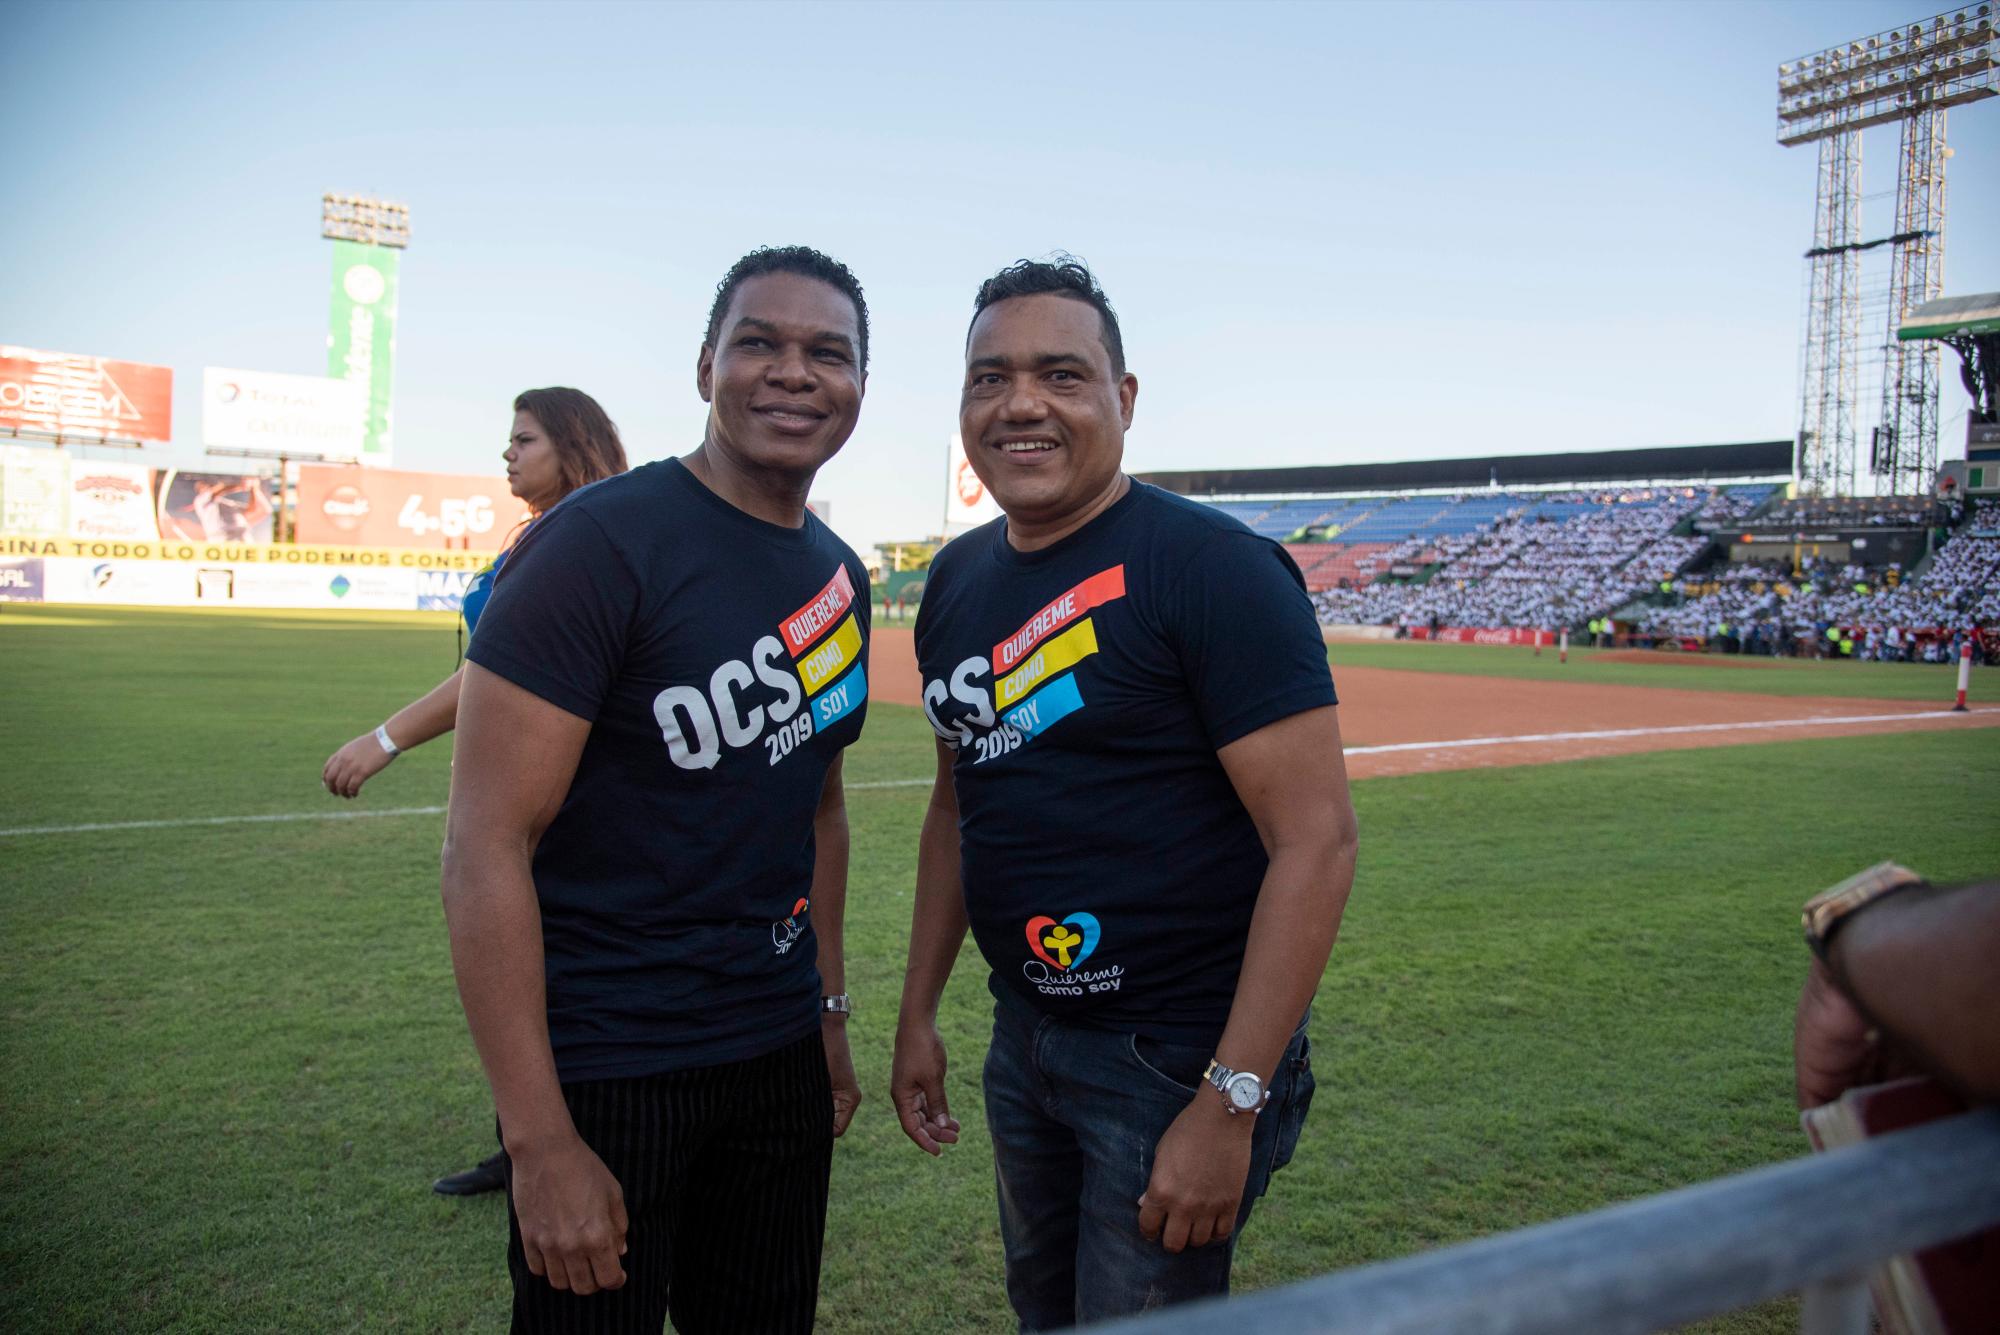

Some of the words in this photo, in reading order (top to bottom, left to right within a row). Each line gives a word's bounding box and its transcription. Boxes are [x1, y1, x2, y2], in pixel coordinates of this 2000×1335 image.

[397, 494, 495, 537] 4.5G
[0, 539, 58, 555] INA
[72, 542, 150, 559] TODO
[162, 545, 195, 561] LO
[205, 546, 257, 562] QUE
[268, 548, 391, 567] PODEMOS
[788, 585, 843, 646] QUIEREME
[1002, 592, 1076, 664] QUIEREME
[806, 642, 843, 684] COMO
[1004, 654, 1045, 698] COMO
[653, 635, 801, 770] QCS
[819, 684, 849, 721] SOY
[1010, 699, 1041, 732] SOY
[764, 712, 813, 767] 2019
[973, 724, 1023, 765] 2019
[1038, 985, 1083, 995] como
[1088, 978, 1121, 993] soy
